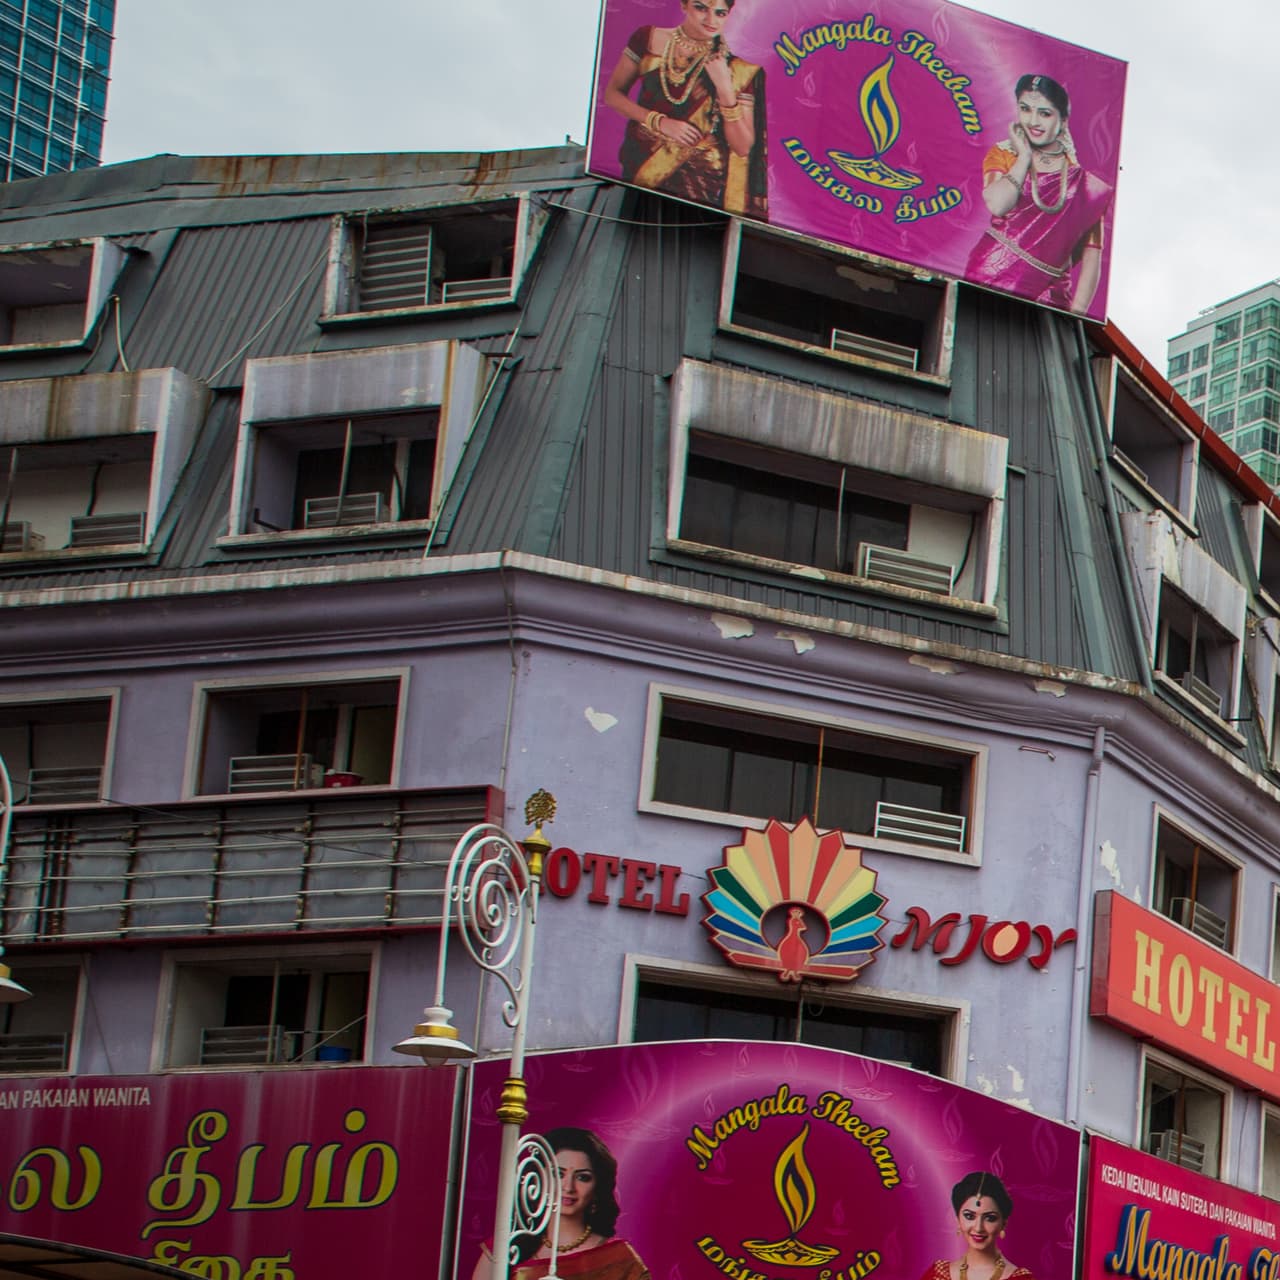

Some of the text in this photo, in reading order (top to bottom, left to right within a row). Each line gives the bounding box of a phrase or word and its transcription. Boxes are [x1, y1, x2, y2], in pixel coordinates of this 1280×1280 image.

[773, 14, 984, 136] Mangala Theebam
[781, 136, 964, 225] மங்கல தீபம்
[891, 905, 1078, 970] MJOY
[1131, 929, 1277, 1074] HOTEL
[22, 1089, 90, 1109] PAKAIAN
[93, 1087, 151, 1107] WANITA
[685, 1083, 902, 1190] Mangala Theebam
[140, 1107, 400, 1240] தீபம்
[1102, 1163, 1126, 1189] KEDAI
[1126, 1174, 1162, 1201] MENJUAL
[1162, 1186, 1181, 1207] KAIN
[1181, 1192, 1208, 1218] SUTERA
[1209, 1202, 1225, 1222] DAN
[1225, 1207, 1252, 1232] PAKAIAN
